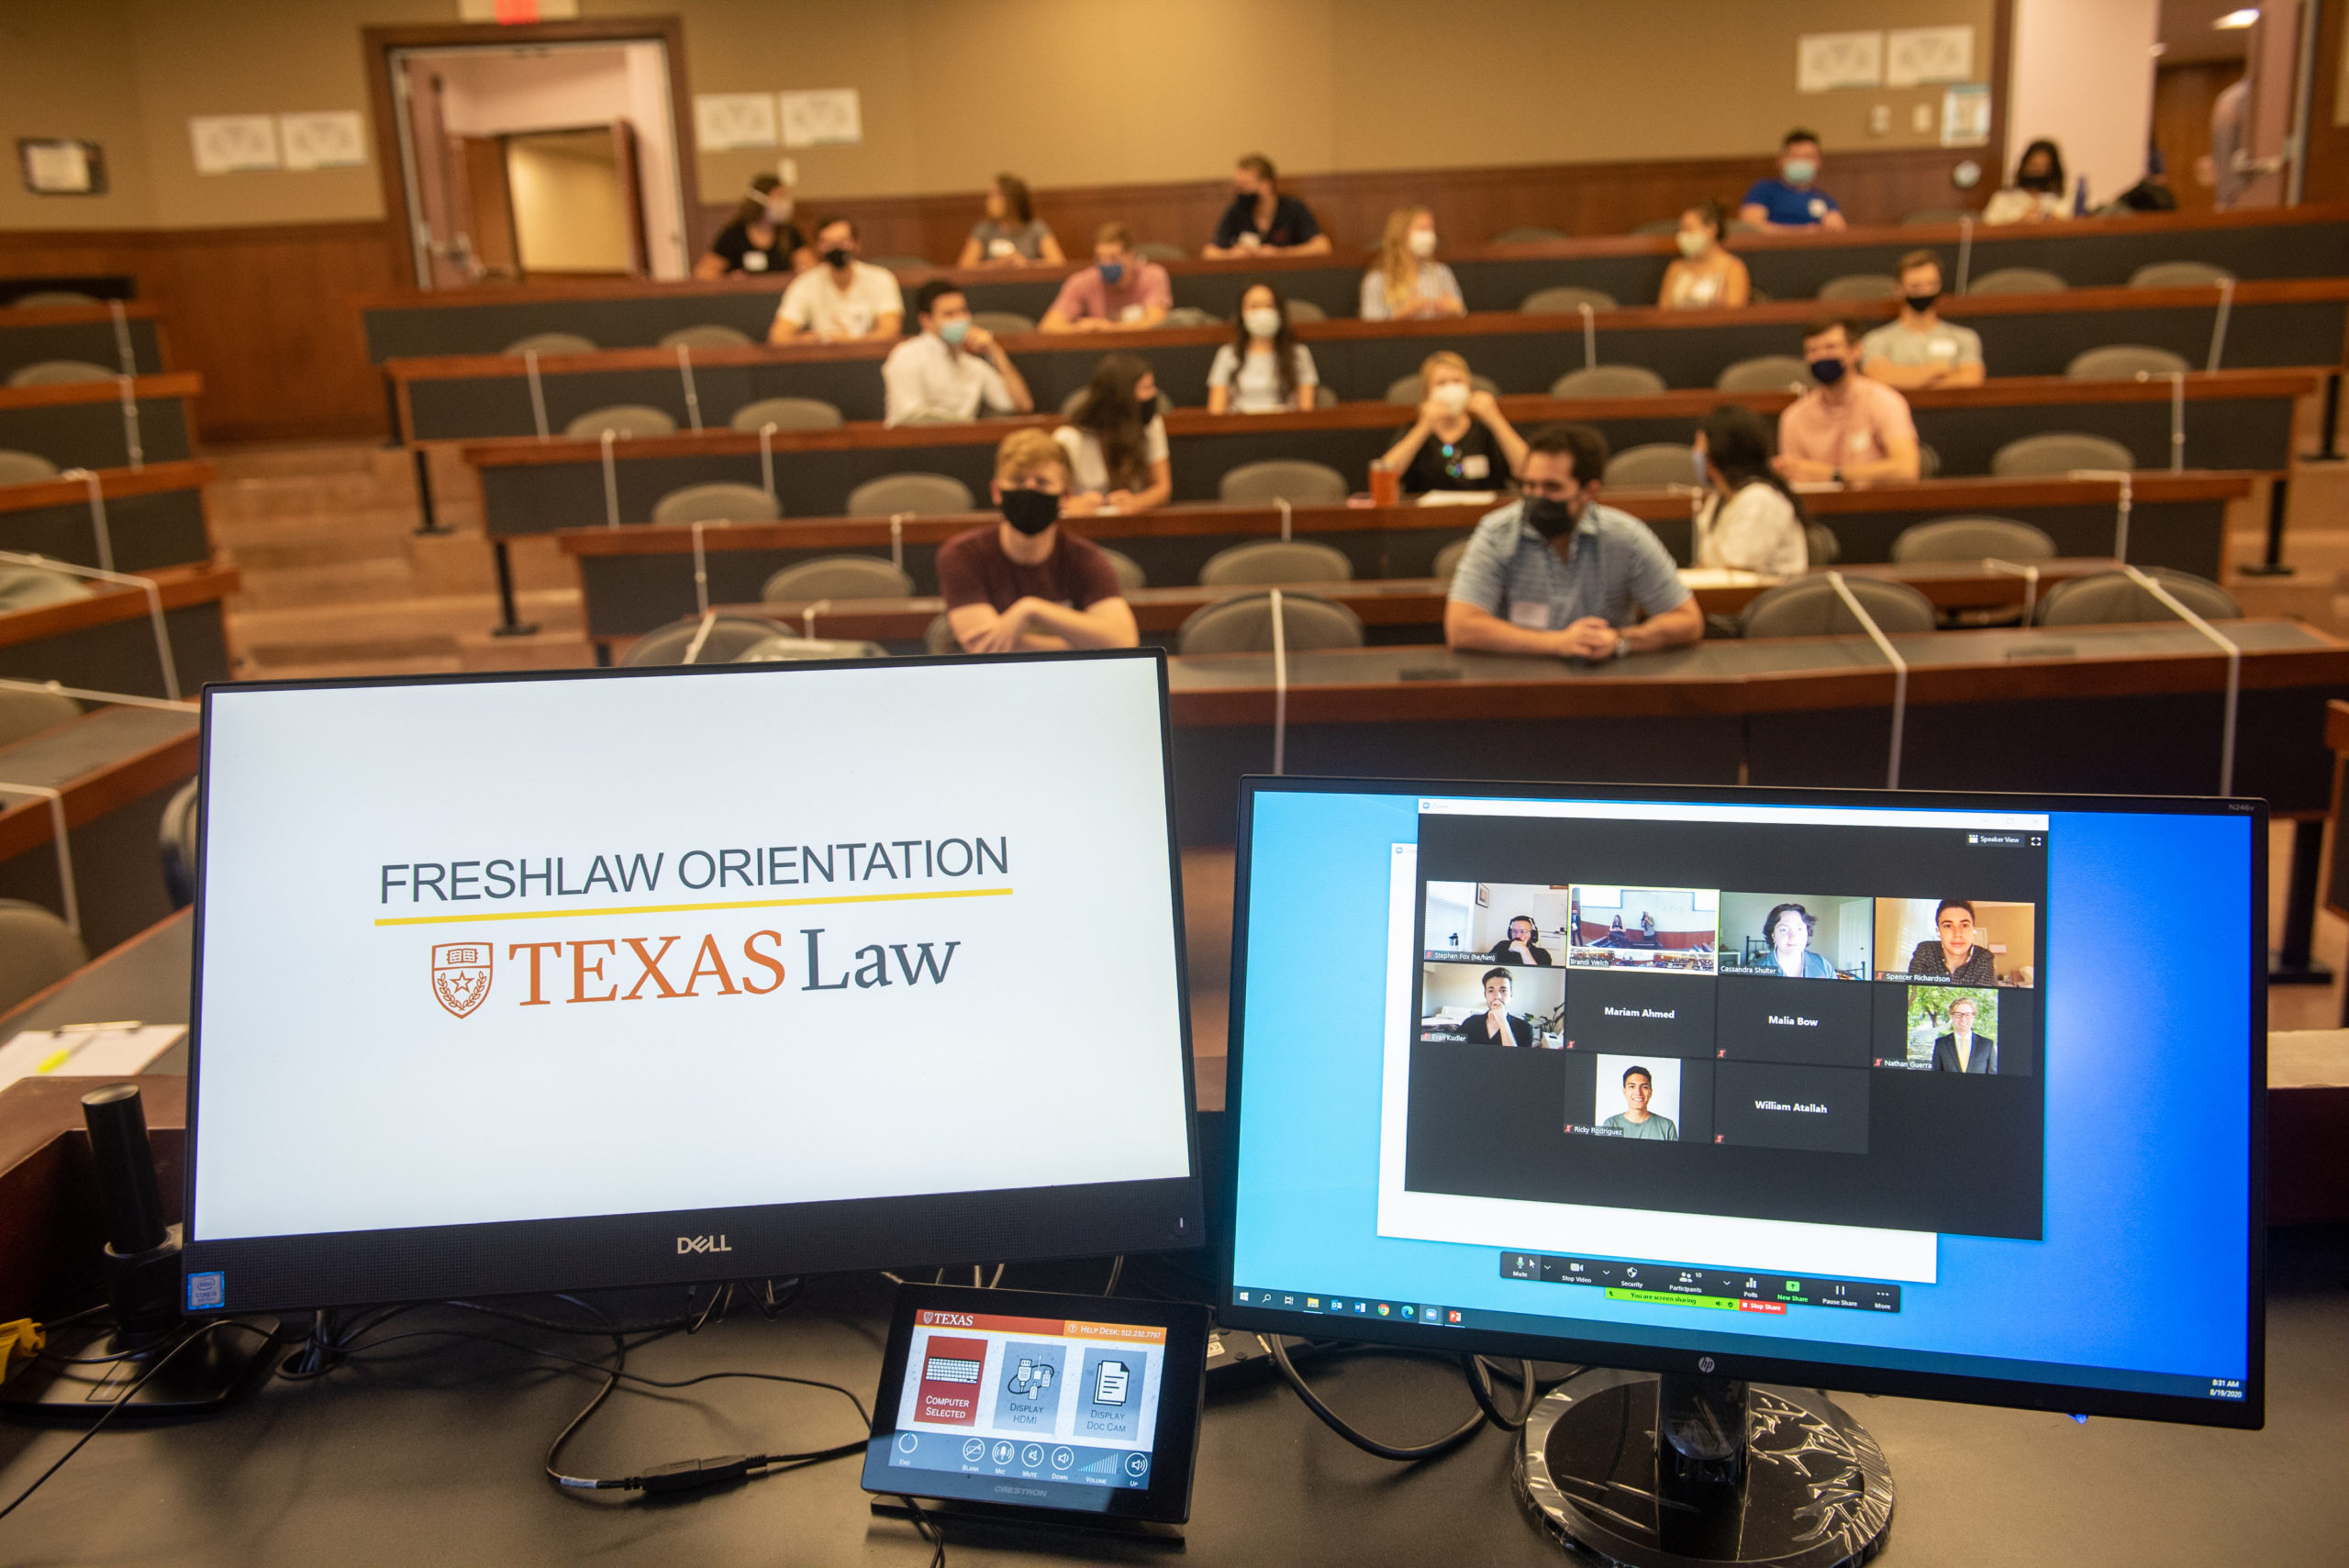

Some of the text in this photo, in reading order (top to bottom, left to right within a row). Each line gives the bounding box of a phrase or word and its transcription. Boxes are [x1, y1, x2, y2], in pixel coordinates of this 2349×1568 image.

[1980, 836, 2004, 844] Speaker
[382, 836, 1008, 904] FRESHLAW ORIENTATION
[1434, 951, 1458, 961] Stephen
[509, 929, 961, 1006] TEXAS Law
[1886, 973, 1951, 983] Spencer Richardson
[1604, 1006, 1675, 1019] Mariam Ahmed
[1768, 1015, 1819, 1027] Malia Bow
[1446, 1034, 1466, 1042] Kudler
[1884, 1059, 1909, 1067] Nathan
[1754, 1100, 1828, 1114] William Atallah
[1574, 1126, 1623, 1137] Ricky Rodriguez
[677, 1234, 732, 1254] DELL
[1620, 1280, 1643, 1289] Security
[1669, 1284, 1702, 1294] Participants
[1675, 1296, 1697, 1305] sharing
[1791, 1295, 1809, 1303] Share
[1822, 1297, 1858, 1307] Pause Share
[1874, 1302, 1891, 1310] More
[935, 1313, 974, 1327] TEXAS
[1120, 1329, 1161, 1339] 512.232.7797
[2210, 1388, 2243, 1398] 8/19/2020
[925, 1395, 970, 1408] COMPUTER
[925, 1407, 966, 1419] SELECTED
[1009, 1402, 1044, 1414] DISPLAY
[1013, 1415, 1038, 1425] HDMI
[1090, 1409, 1125, 1421] DISPLAY
[1086, 1420, 1127, 1433] DOC CAM
[1022, 1470, 1038, 1478] MUTE
[1052, 1473, 1068, 1481] DOWN
[1085, 1476, 1108, 1485] VOLUME
[994, 1485, 1047, 1497] CRESTRON
